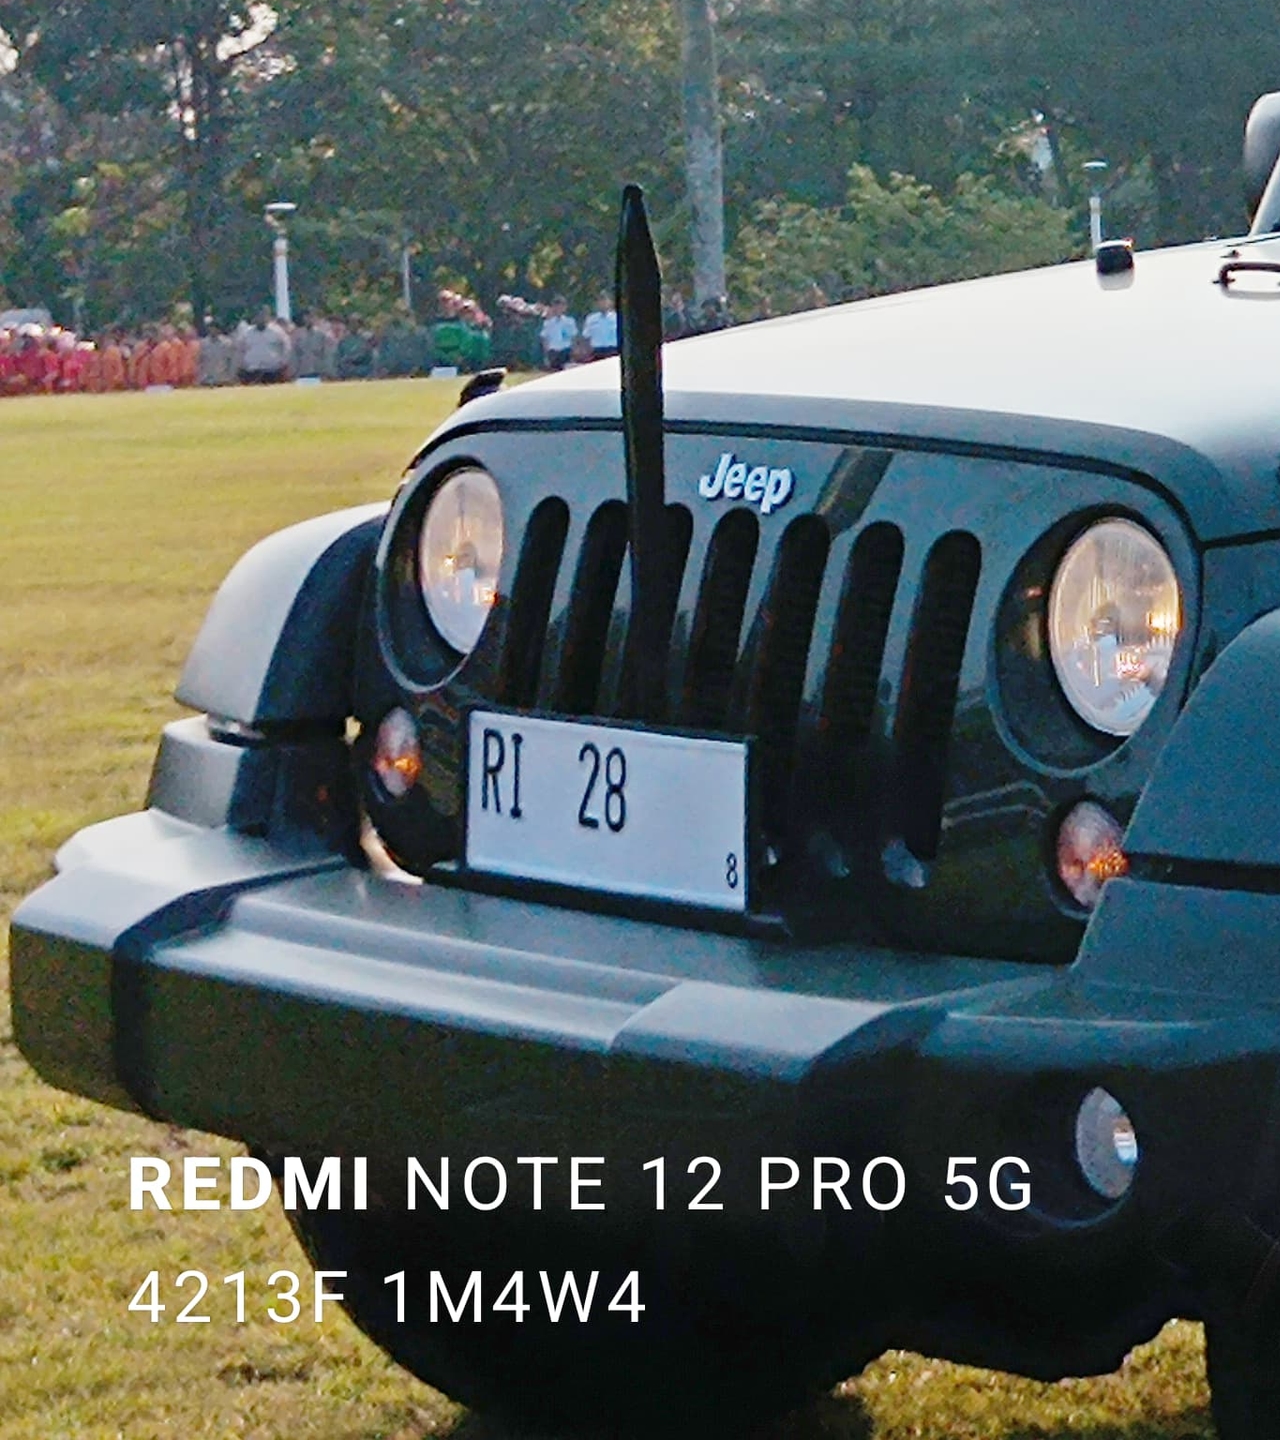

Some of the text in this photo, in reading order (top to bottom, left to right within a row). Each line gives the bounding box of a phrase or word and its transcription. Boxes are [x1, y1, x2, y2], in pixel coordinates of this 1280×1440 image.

[699, 452, 796, 515] Jeep
[480, 727, 629, 833] RI 28
[725, 851, 740, 890] 8
